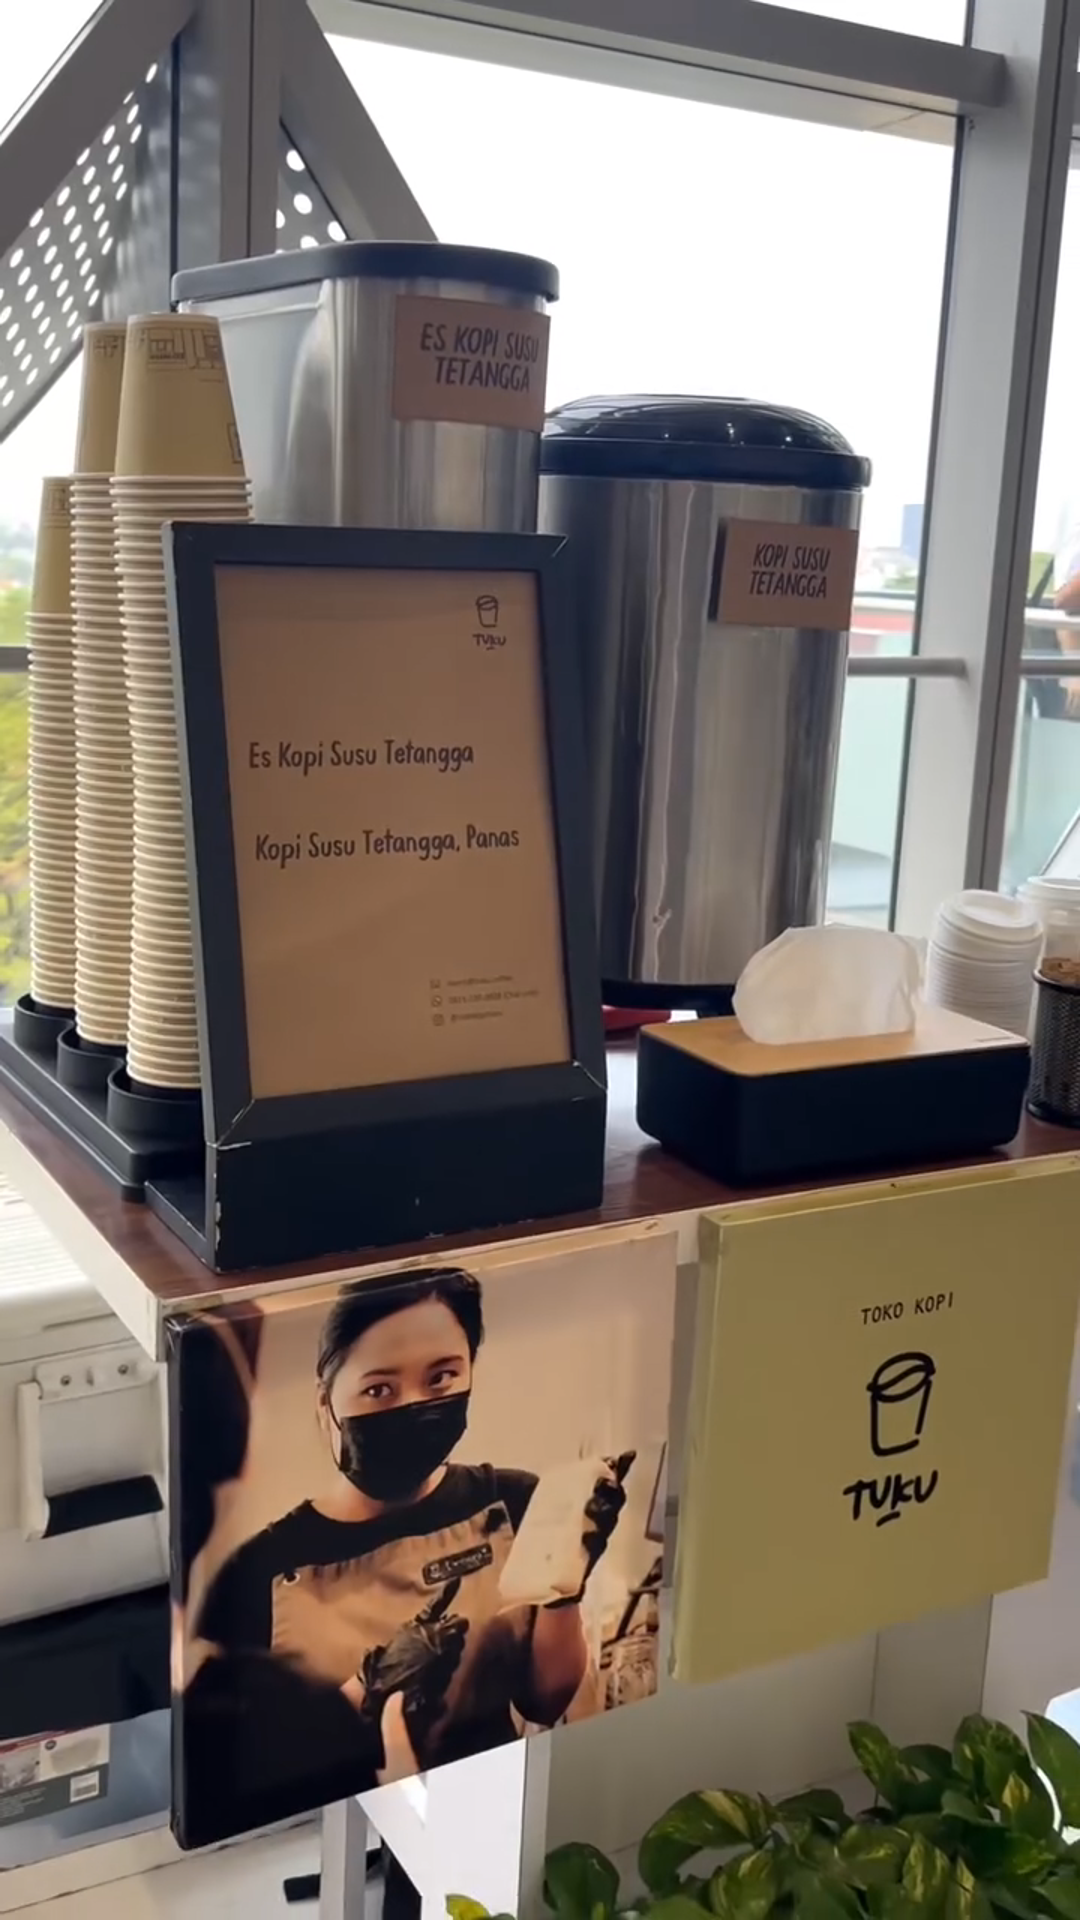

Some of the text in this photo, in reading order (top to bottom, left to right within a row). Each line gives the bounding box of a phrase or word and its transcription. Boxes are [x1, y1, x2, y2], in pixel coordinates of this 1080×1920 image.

[420, 322, 539, 363] ES KOPI SUSU
[435, 356, 531, 392] TETANGGA
[753, 543, 831, 572] KOPI SUSU
[749, 571, 827, 598] TETANGGA
[472, 633, 507, 650] TUKU
[249, 739, 474, 776] Es Kopi Susu Tetangga
[256, 824, 520, 869] Kopi Susu Tetangga, Panas
[861, 1292, 953, 1325] TOKO KOPI
[843, 1469, 938, 1524] TUKU
